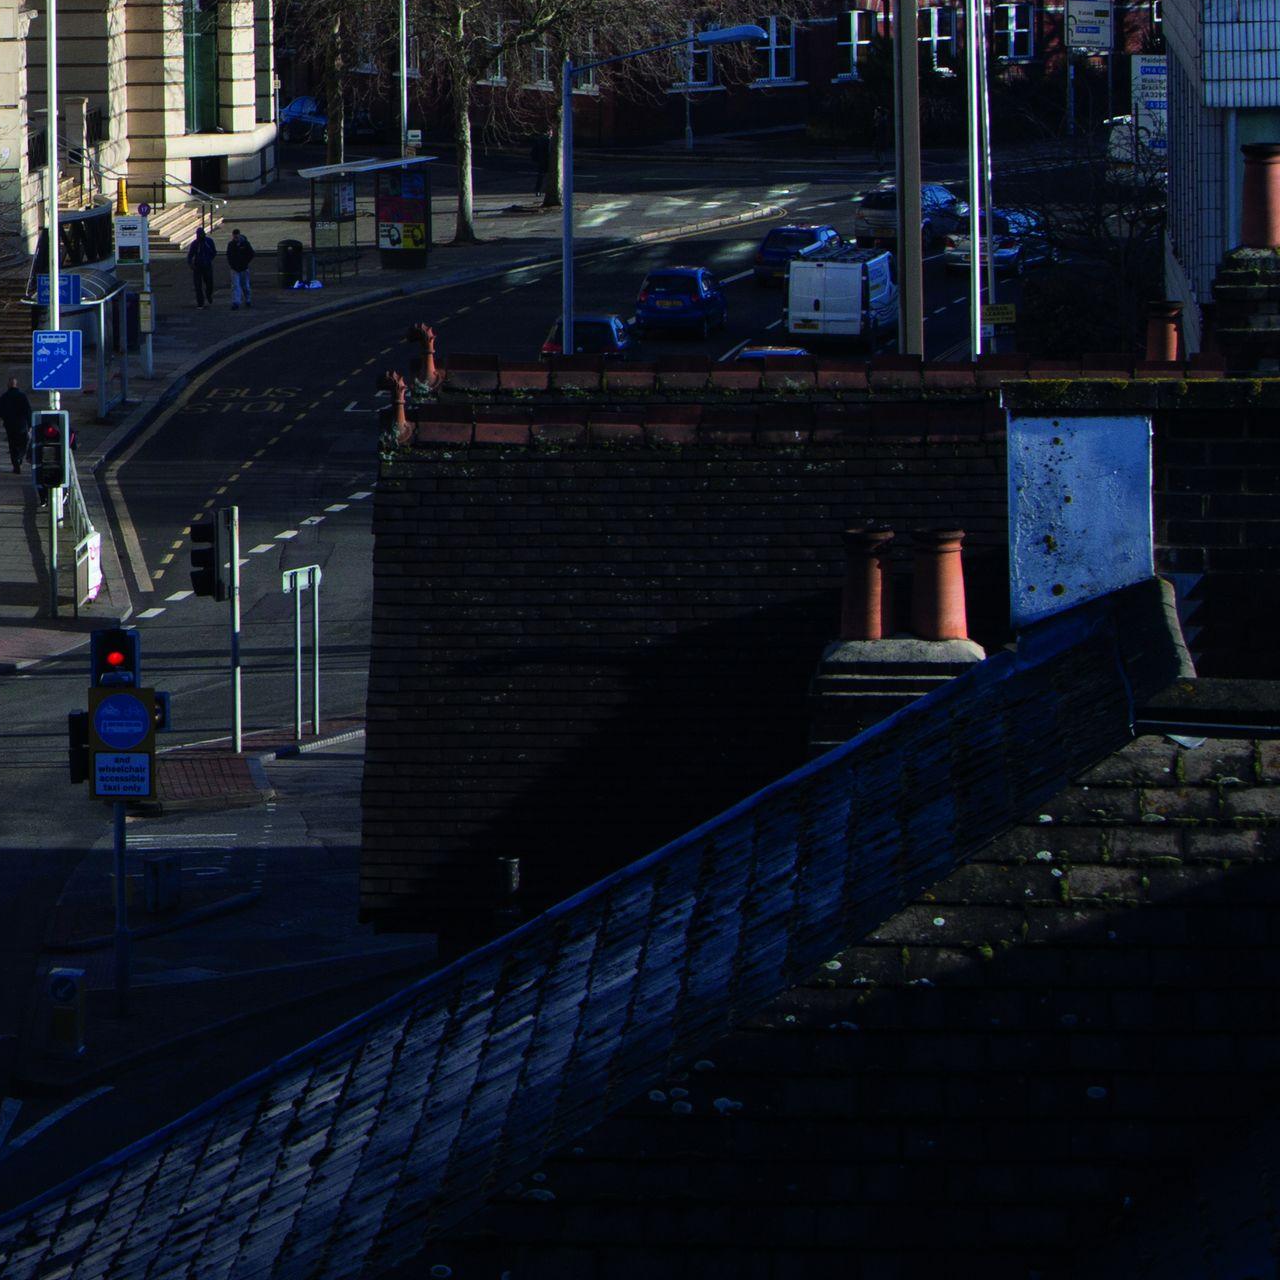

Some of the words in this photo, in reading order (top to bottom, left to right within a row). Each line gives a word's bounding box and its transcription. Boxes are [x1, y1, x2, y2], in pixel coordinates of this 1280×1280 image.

[206, 387, 303, 399] BUS
[114, 756, 130, 764] and
[98, 765, 146, 773] wheelchair
[99, 774, 145, 782] accessible
[103, 783, 120, 792] taxi
[122, 784, 142, 793] only
